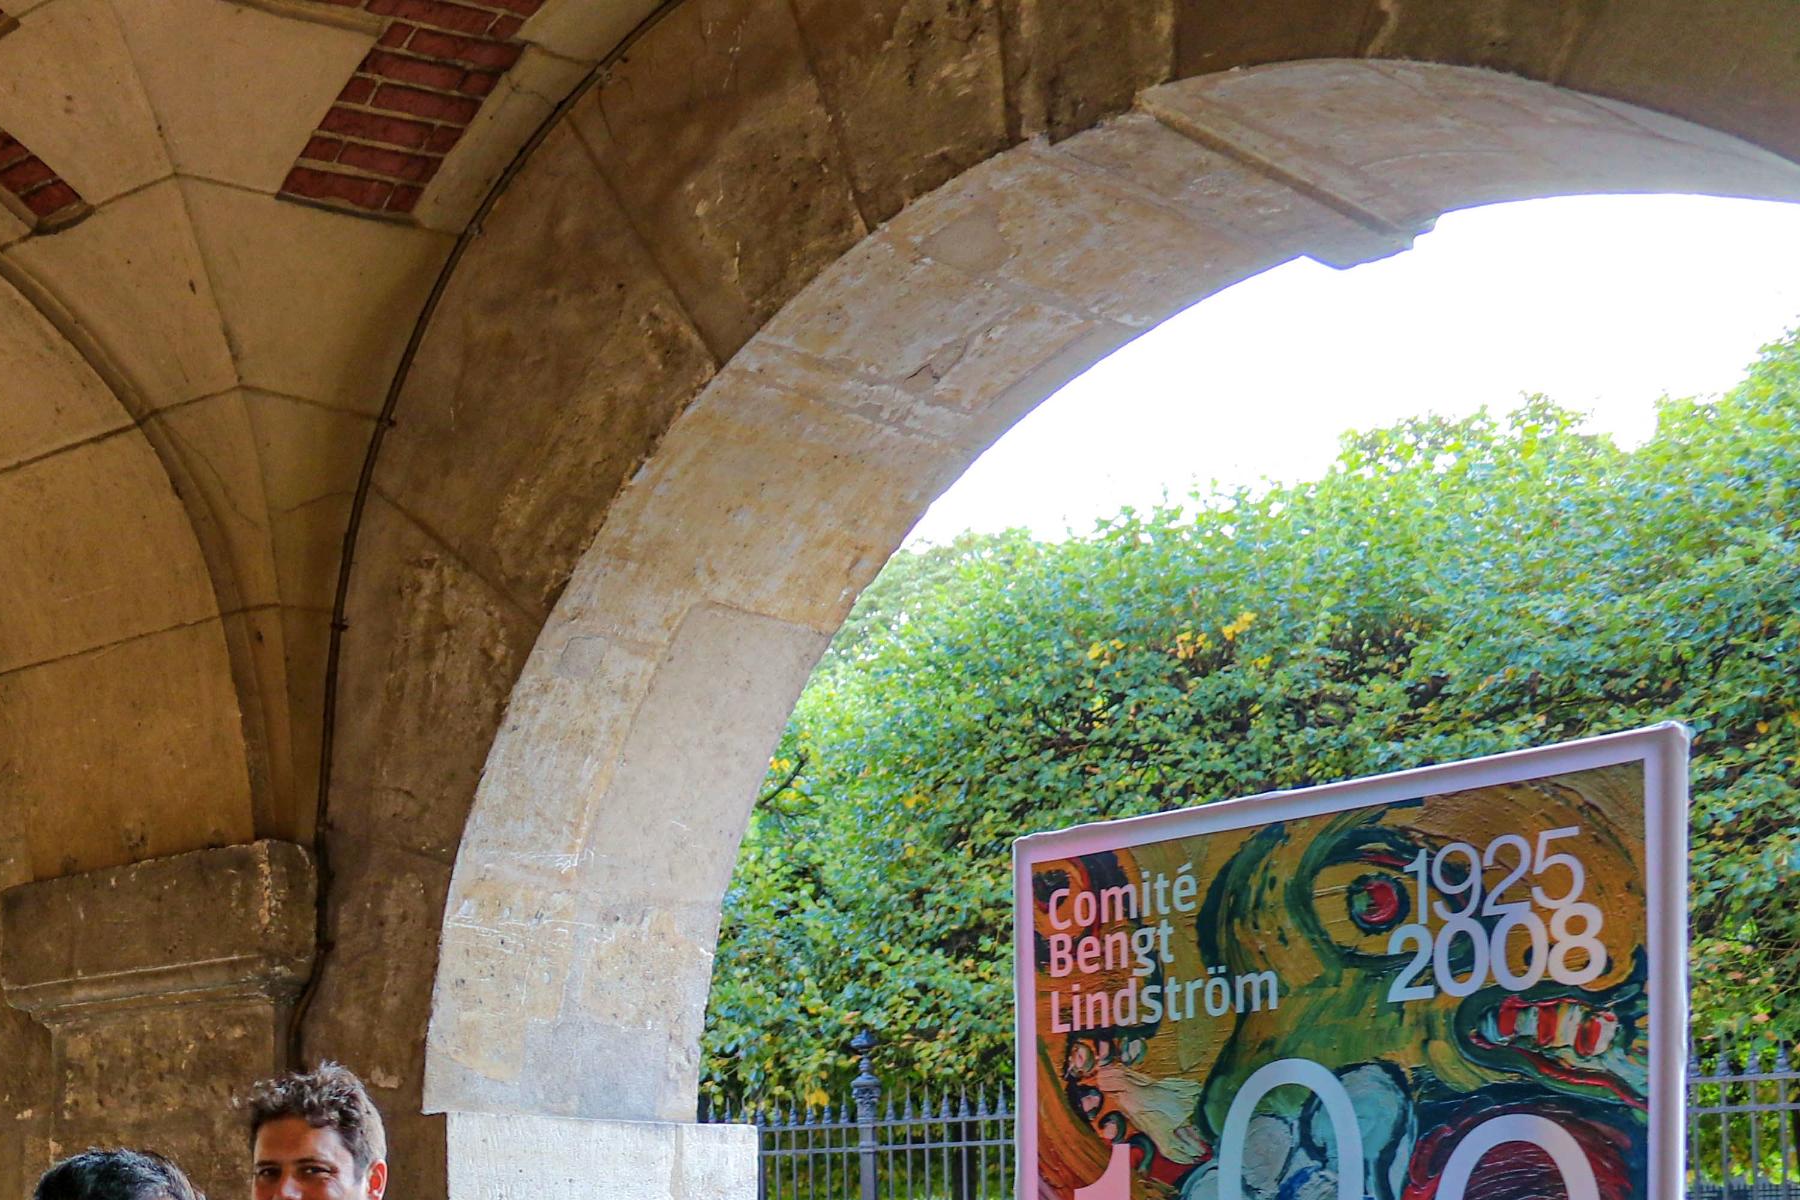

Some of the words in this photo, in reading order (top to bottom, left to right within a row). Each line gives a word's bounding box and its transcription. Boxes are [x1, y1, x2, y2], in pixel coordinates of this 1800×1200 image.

[1049, 863, 1198, 930] Comité
[1403, 826, 1585, 925] 1925
[1049, 919, 1175, 978] Bengt
[1387, 902, 1607, 1003] 2008
[1051, 966, 1279, 1034] Lindström
